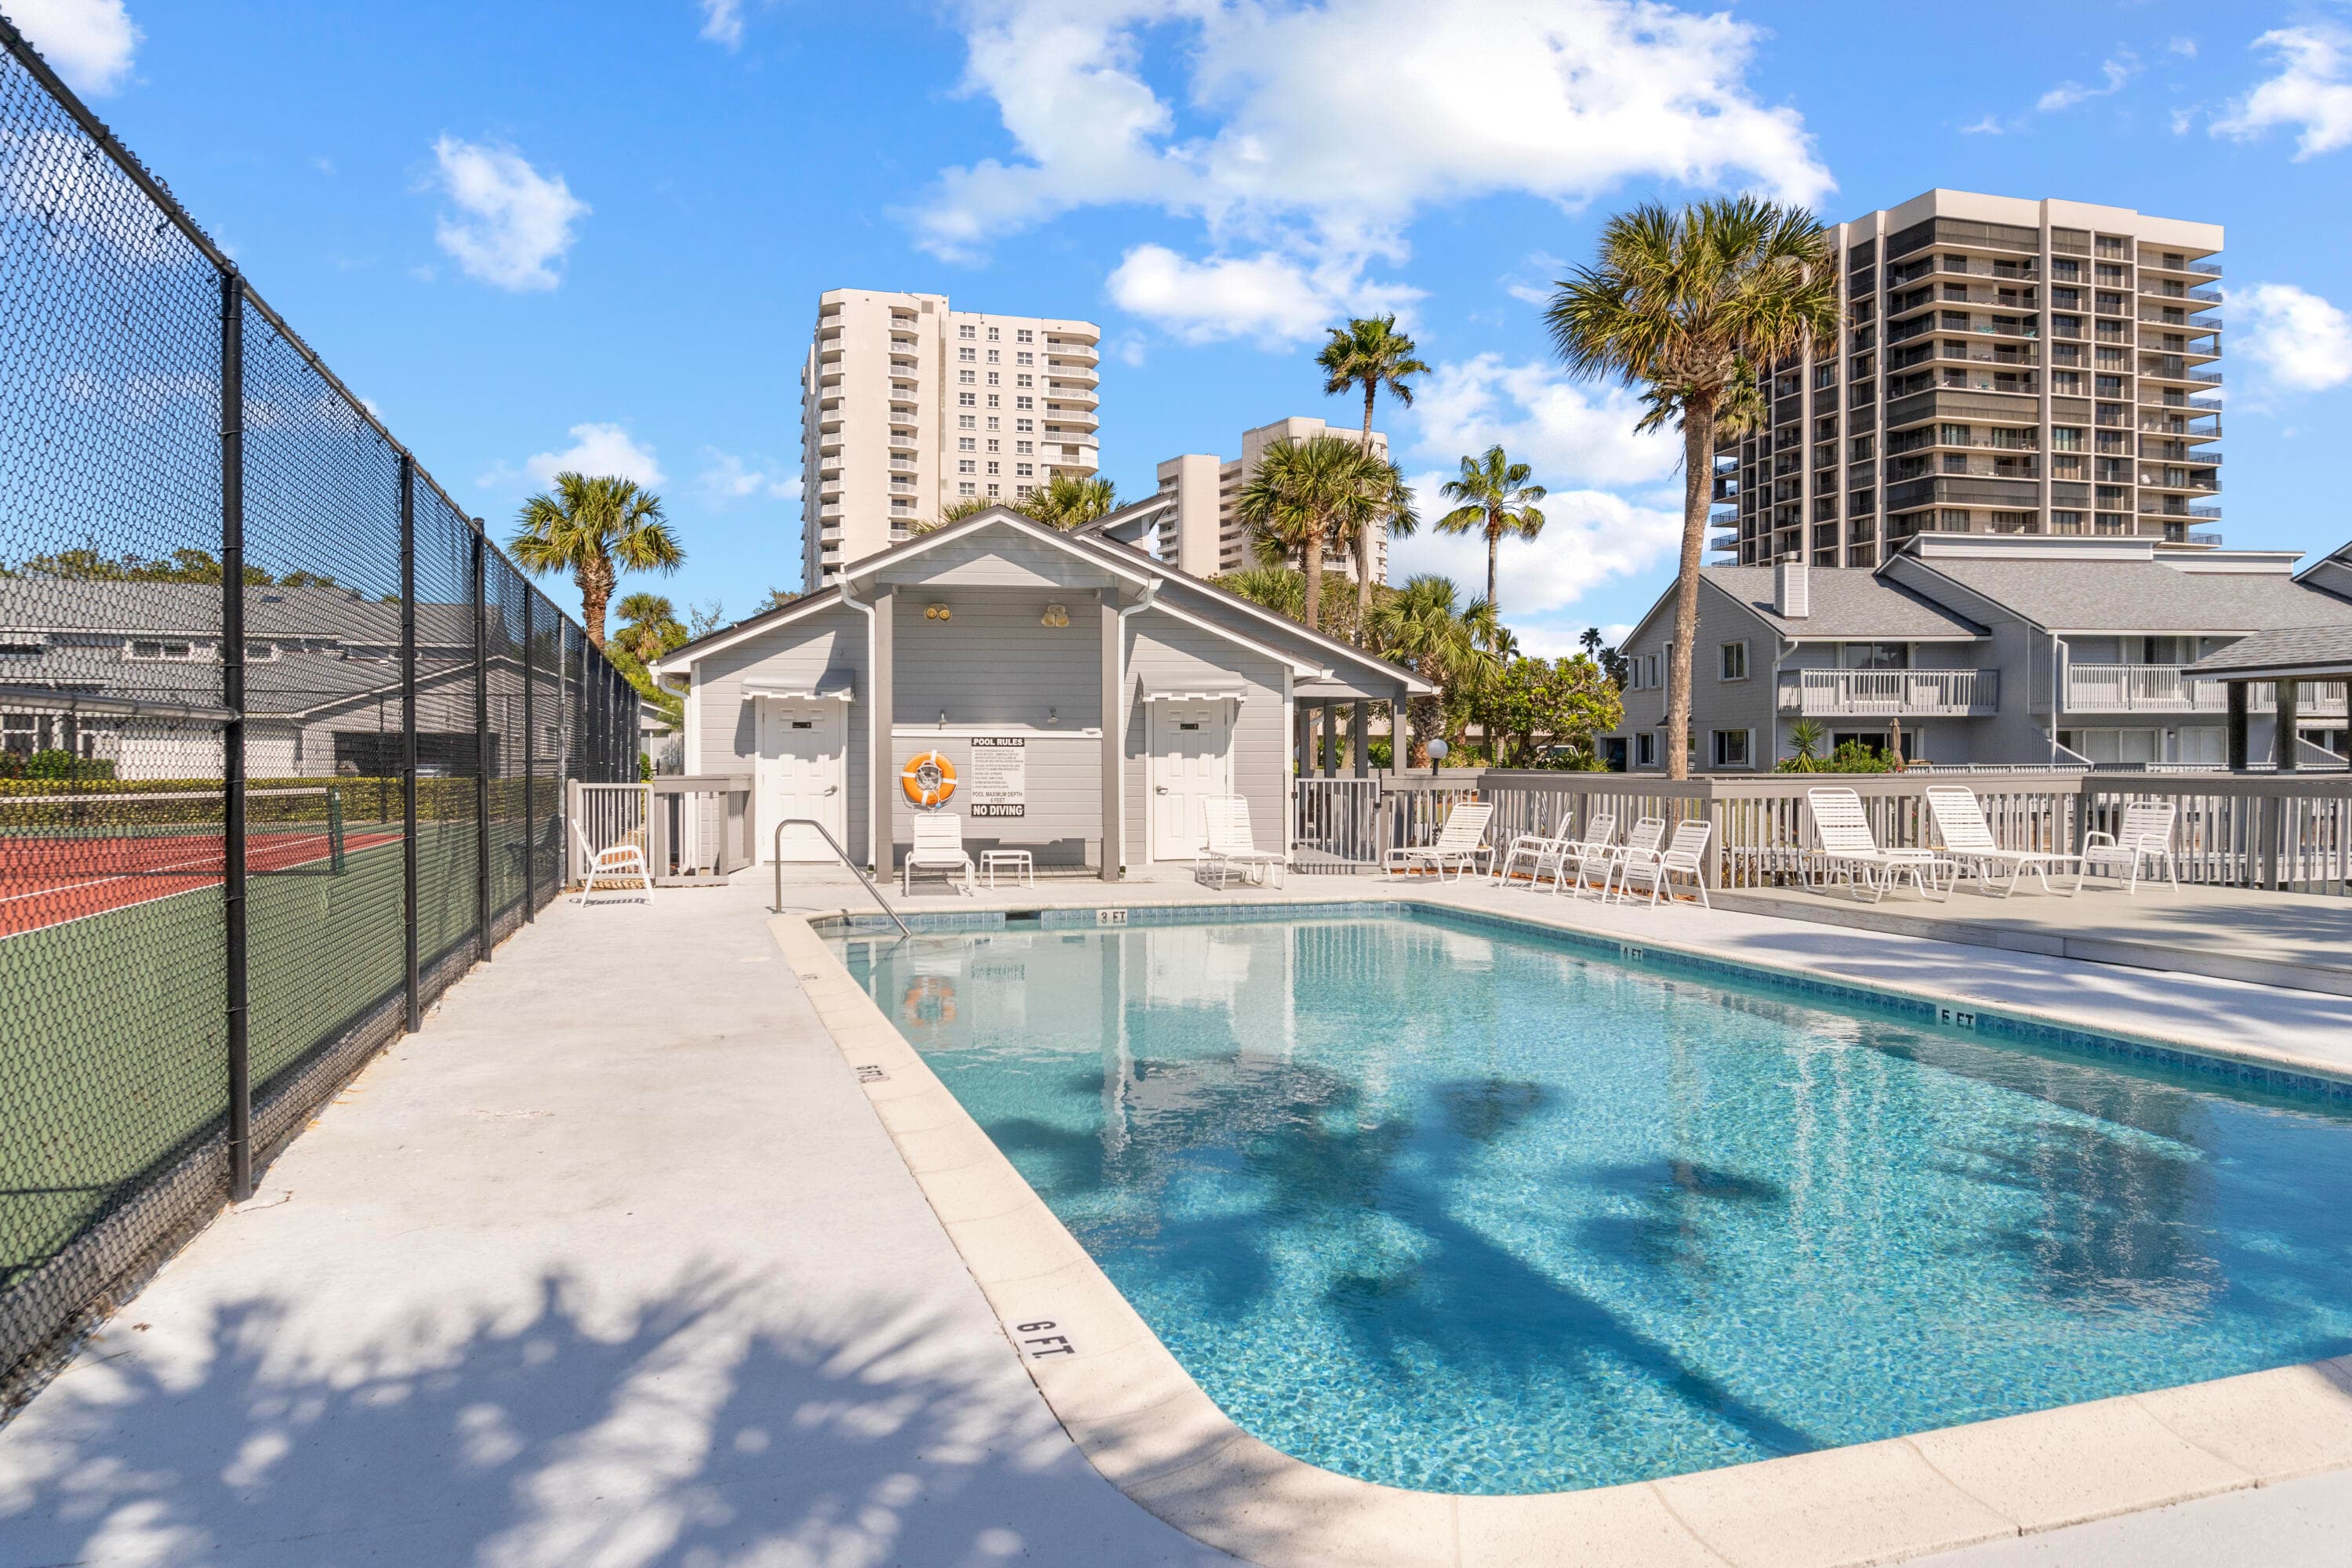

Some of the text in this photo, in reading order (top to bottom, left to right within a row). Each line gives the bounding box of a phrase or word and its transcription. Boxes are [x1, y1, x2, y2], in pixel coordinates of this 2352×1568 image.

[973, 805, 1023, 815] NO DIVING
[1101, 911, 1107, 922] 3
[1956, 1011, 1974, 1025] FT
[1016, 1320, 1057, 1332] 6
